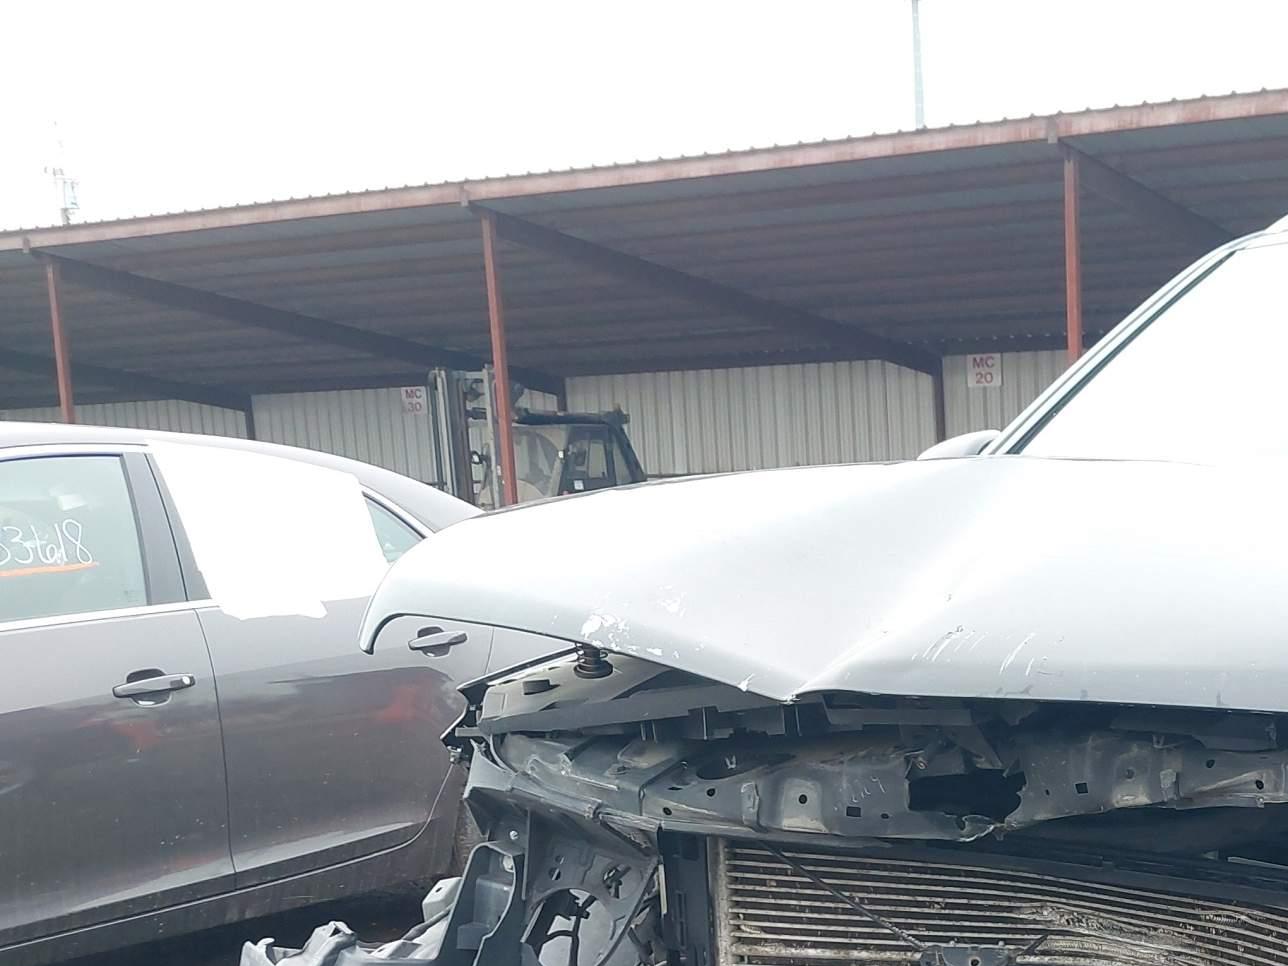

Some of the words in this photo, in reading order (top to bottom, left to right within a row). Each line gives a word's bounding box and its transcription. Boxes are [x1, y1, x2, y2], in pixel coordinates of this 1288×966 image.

[972, 355, 995, 369] MC
[975, 371, 993, 385] 20
[404, 388, 423, 399] MC
[407, 401, 422, 412] 30
